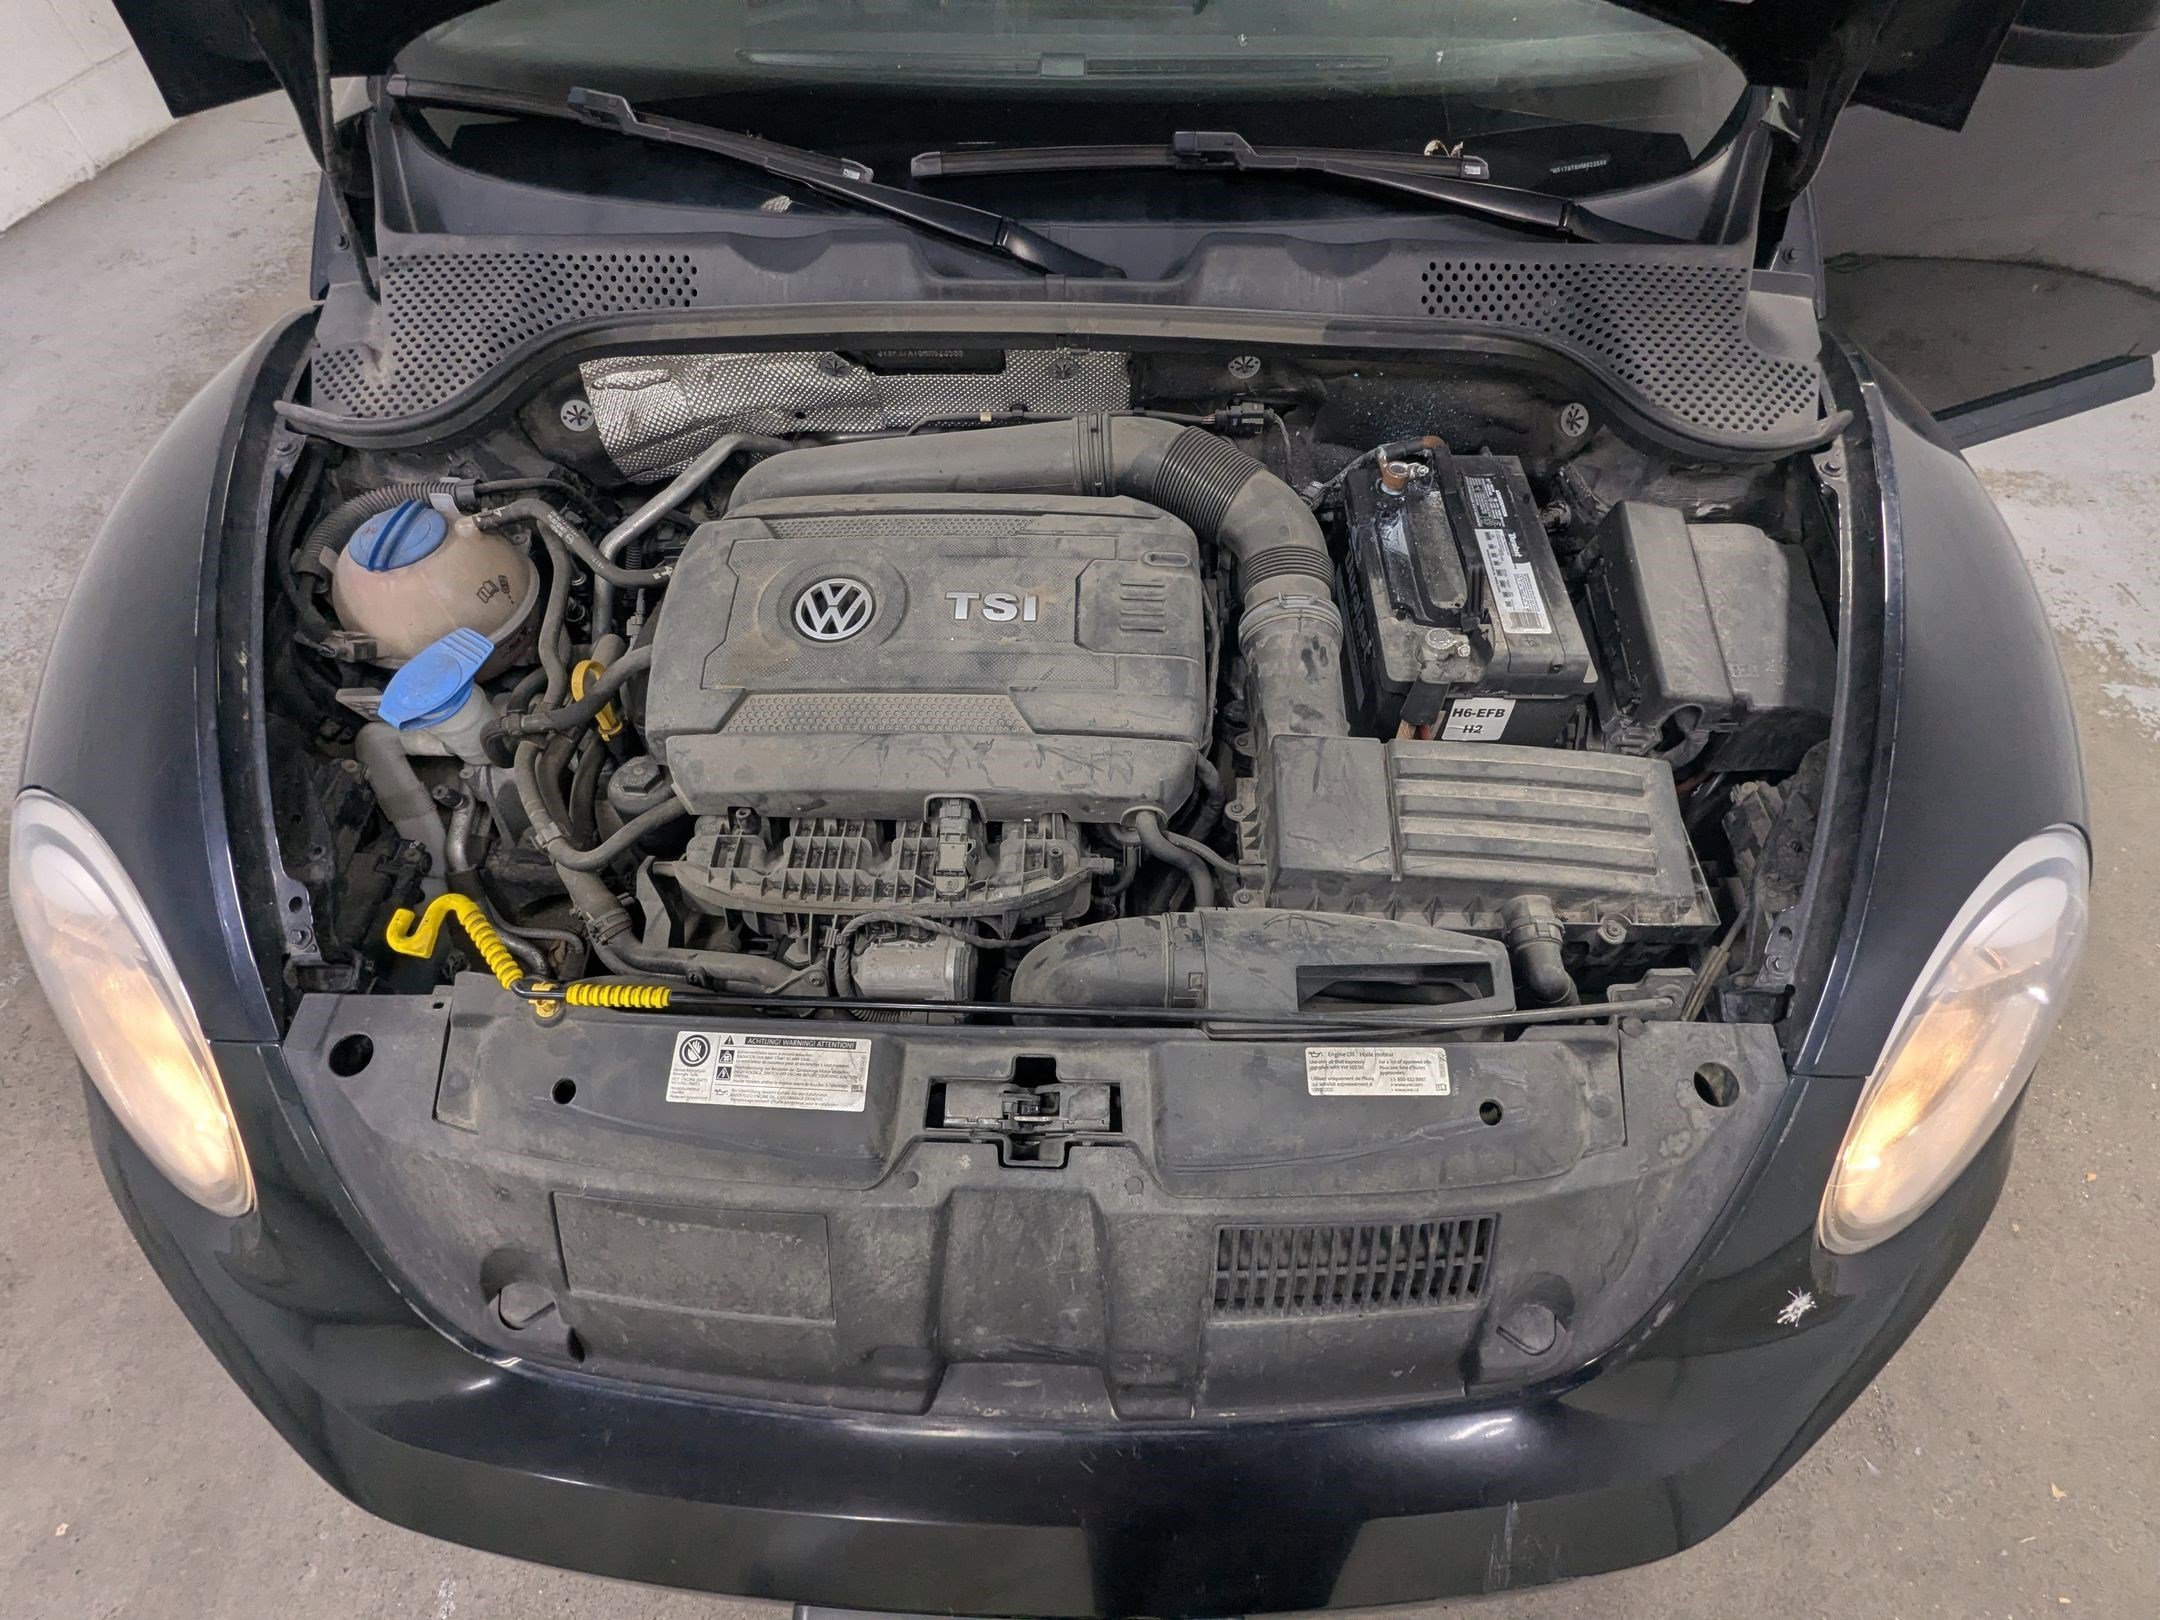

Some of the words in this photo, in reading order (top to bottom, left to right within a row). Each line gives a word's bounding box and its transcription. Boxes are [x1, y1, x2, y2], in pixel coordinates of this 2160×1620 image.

[798, 579, 871, 639] VW
[945, 592, 1038, 622] TSI
[1452, 708, 1506, 718] H6-EFB
[1463, 724, 1483, 734] H2
[747, 1037, 782, 1046] ACHTUNG!
[782, 1039, 816, 1047] WARNING!
[816, 1040, 855, 1049] ATTENTION!
